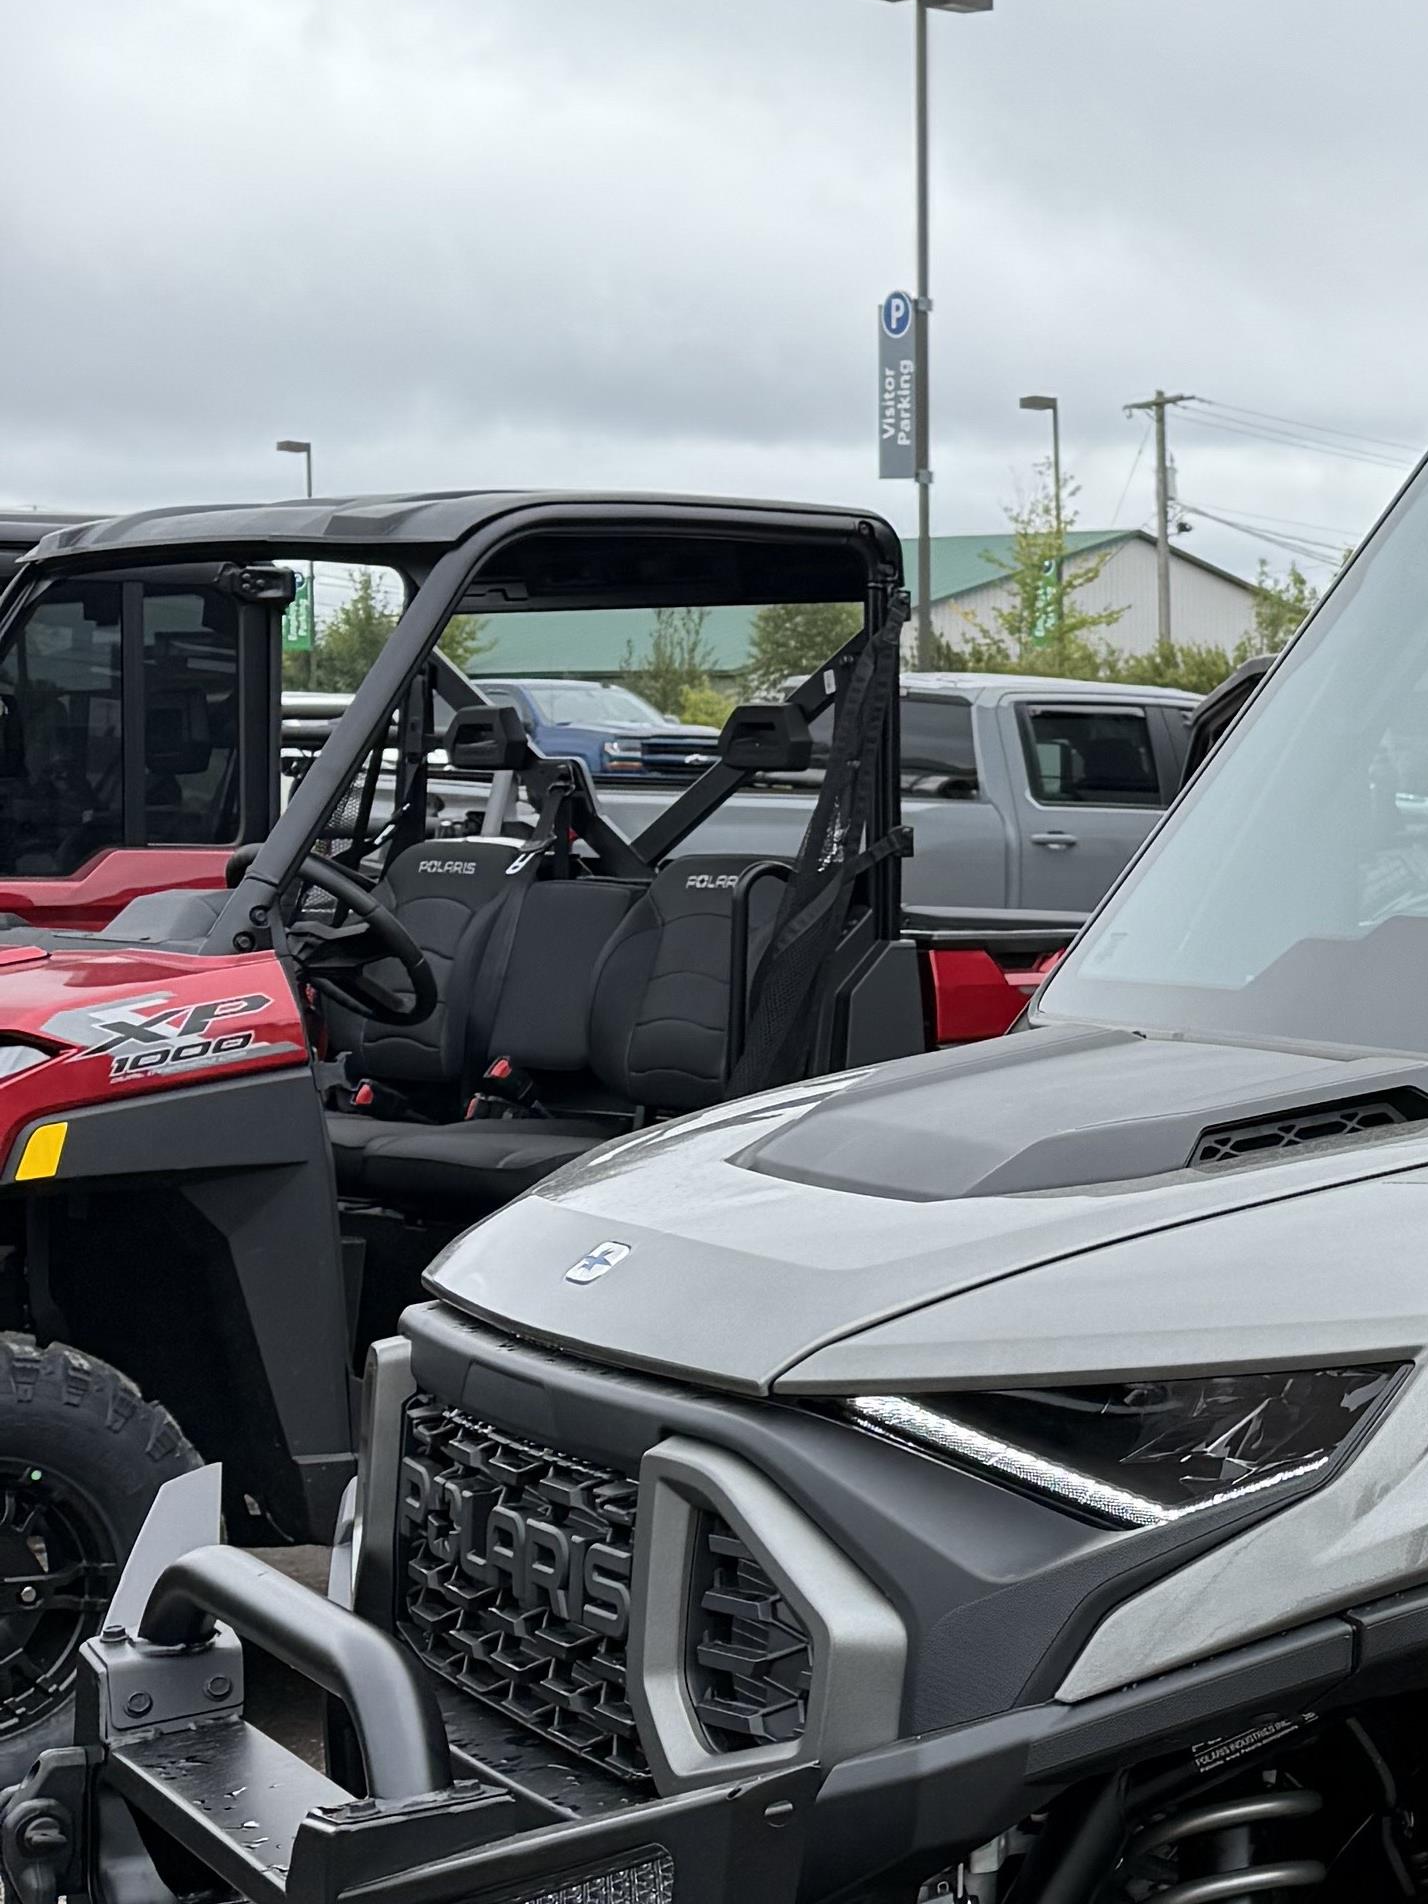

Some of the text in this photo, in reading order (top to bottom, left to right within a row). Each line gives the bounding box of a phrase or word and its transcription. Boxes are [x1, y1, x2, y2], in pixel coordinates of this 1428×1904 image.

[882, 367, 896, 439] Visitor
[897, 358, 915, 446] Parking
[418, 860, 476, 875] POLARIS
[685, 874, 739, 889] POLAR
[80, 992, 275, 1057] XP
[110, 1032, 254, 1076] 1000
[400, 1453, 633, 1639] POLARIS
